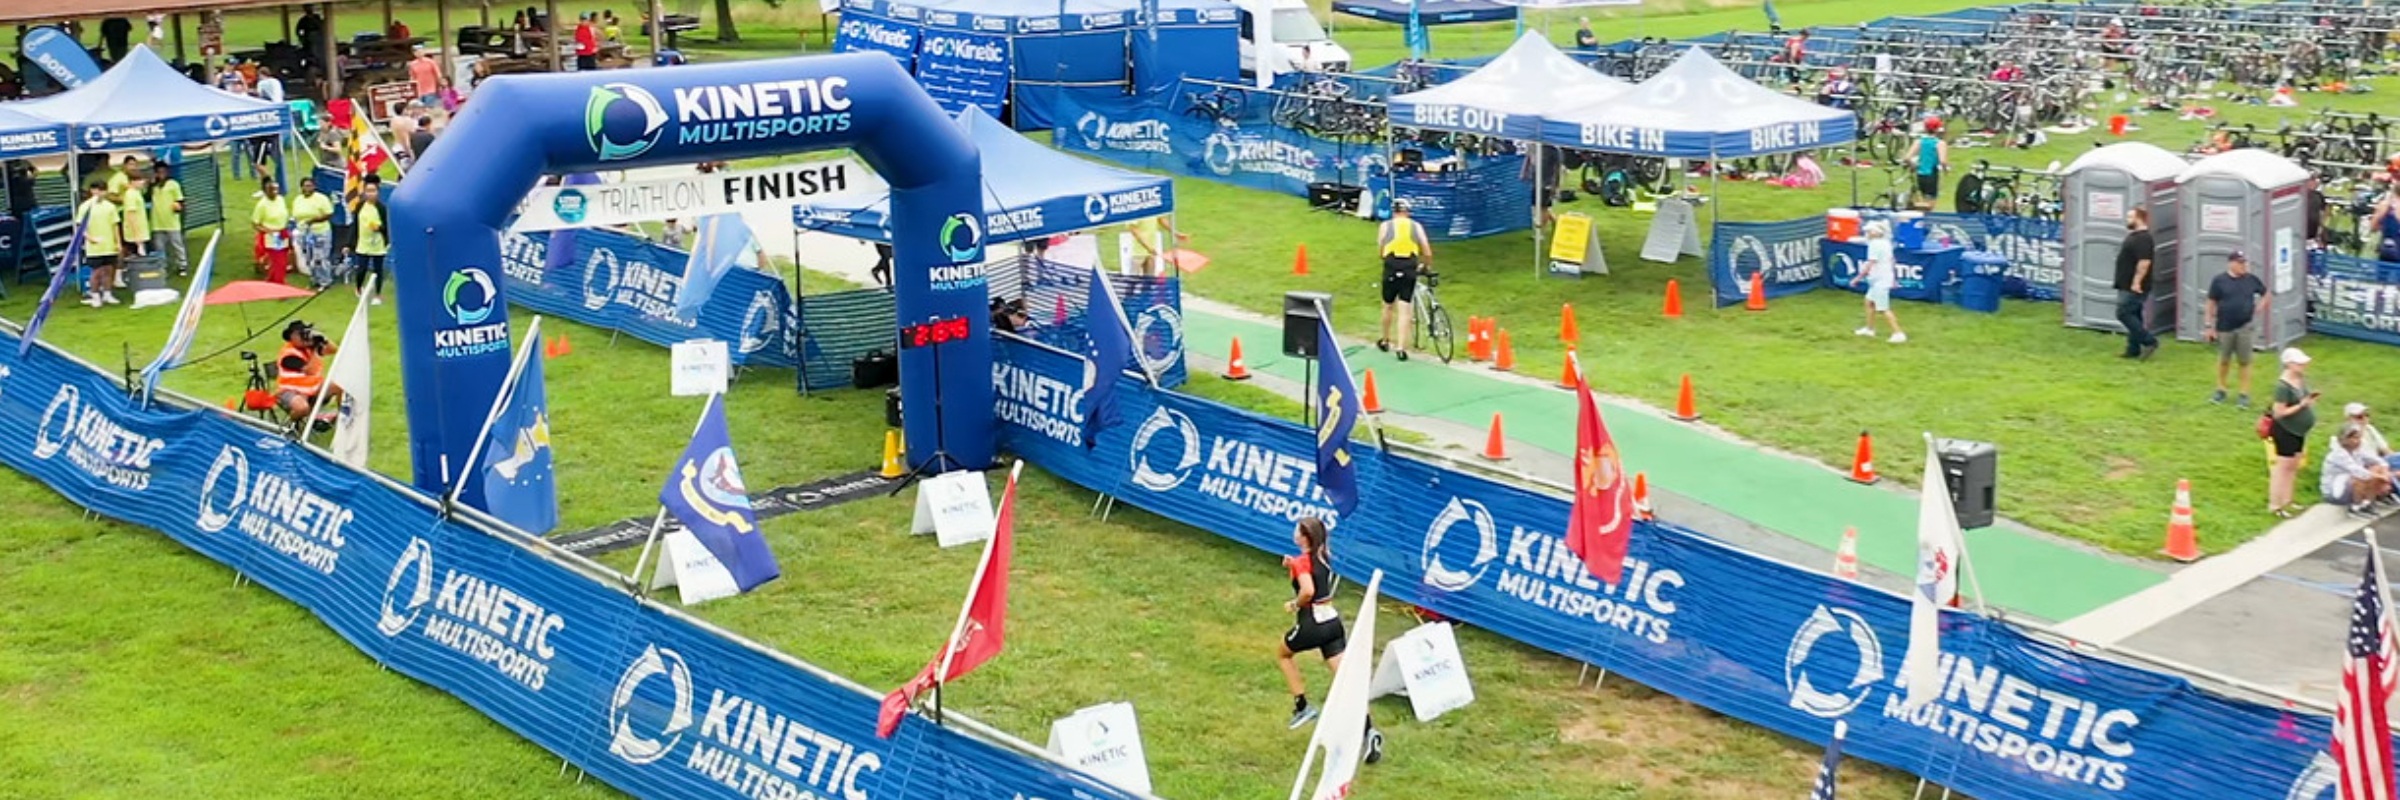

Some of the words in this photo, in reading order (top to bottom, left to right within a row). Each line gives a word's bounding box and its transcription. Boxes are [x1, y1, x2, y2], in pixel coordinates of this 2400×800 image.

[39, 53, 76, 81] BODY
[674, 76, 852, 123] KINETIC
[1413, 104, 1459, 127] BIKE
[1463, 108, 1508, 134] OUT
[679, 112, 852, 145] MULTISPORTS
[1105, 119, 1171, 142] KINETIC
[1581, 122, 1634, 149] BIKE
[1640, 129, 1665, 152] IN
[1751, 123, 1794, 151] BIKE
[1798, 120, 1820, 144] IN
[1237, 139, 1319, 170] KINETIC
[599, 181, 706, 217] TRIATHLON
[724, 165, 846, 206] FINISH
[1109, 186, 1162, 207] KINETIC
[1773, 235, 1823, 269] KINE
[434, 322, 507, 348] KINETIC
[992, 361, 1084, 424] KINETIC
[75, 403, 166, 469] KINETIC
[1206, 436, 1334, 506] KINET
[250, 471, 354, 547] KINETIC
[239, 510, 339, 575] MULTISPORTS
[434, 568, 565, 660] KINETIC
[1496, 568, 1672, 645] MULTISPORTS
[423, 614, 549, 692] MULTISPORTS
[700, 687, 882, 800] KINETIC
[1882, 692, 2128, 792] MULTISPORTS
